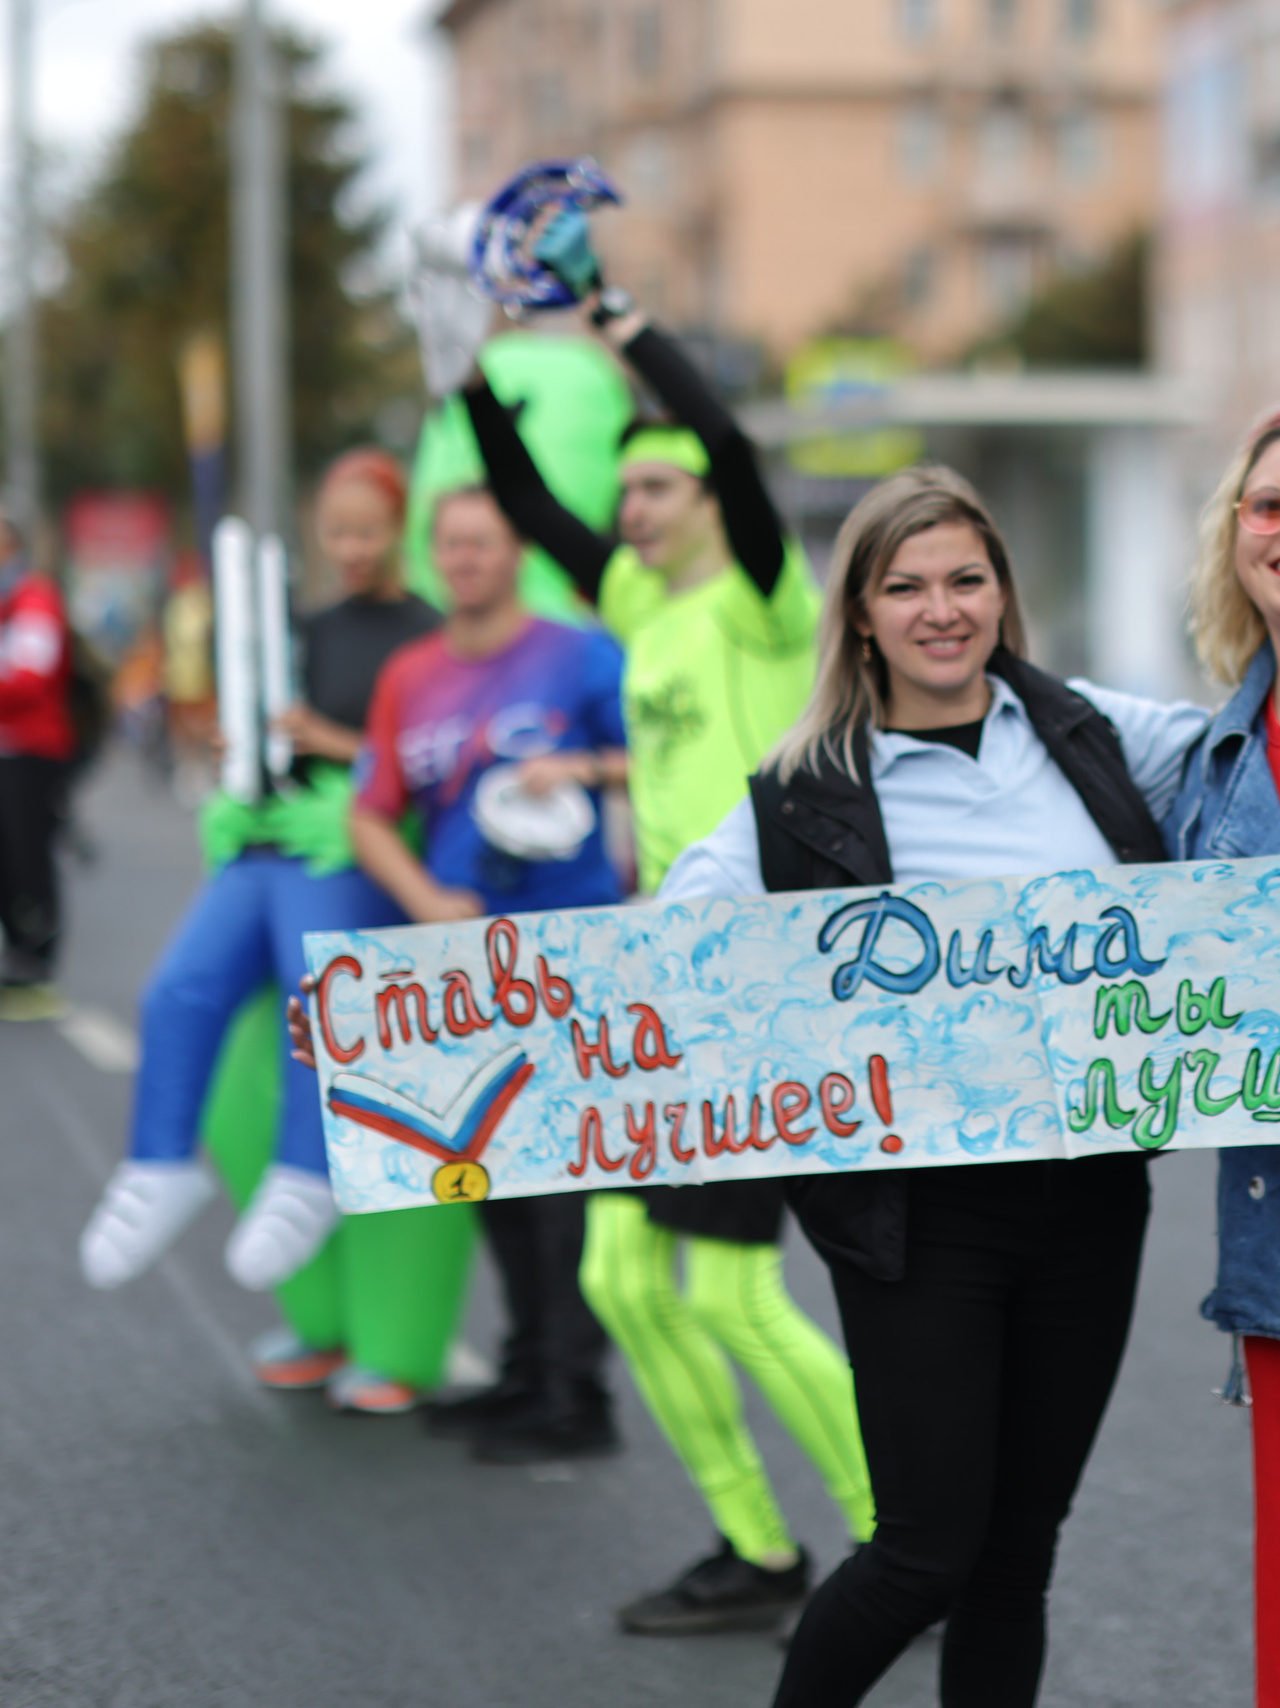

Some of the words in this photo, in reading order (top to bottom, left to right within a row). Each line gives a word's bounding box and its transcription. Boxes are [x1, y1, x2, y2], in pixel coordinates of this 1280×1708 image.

[317, 917, 574, 1064] Ставь
[817, 891, 1168, 1001] Дима
[571, 1003, 683, 1080] на
[1093, 976, 1245, 1040] ты
[567, 1053, 904, 1181] лучшее!
